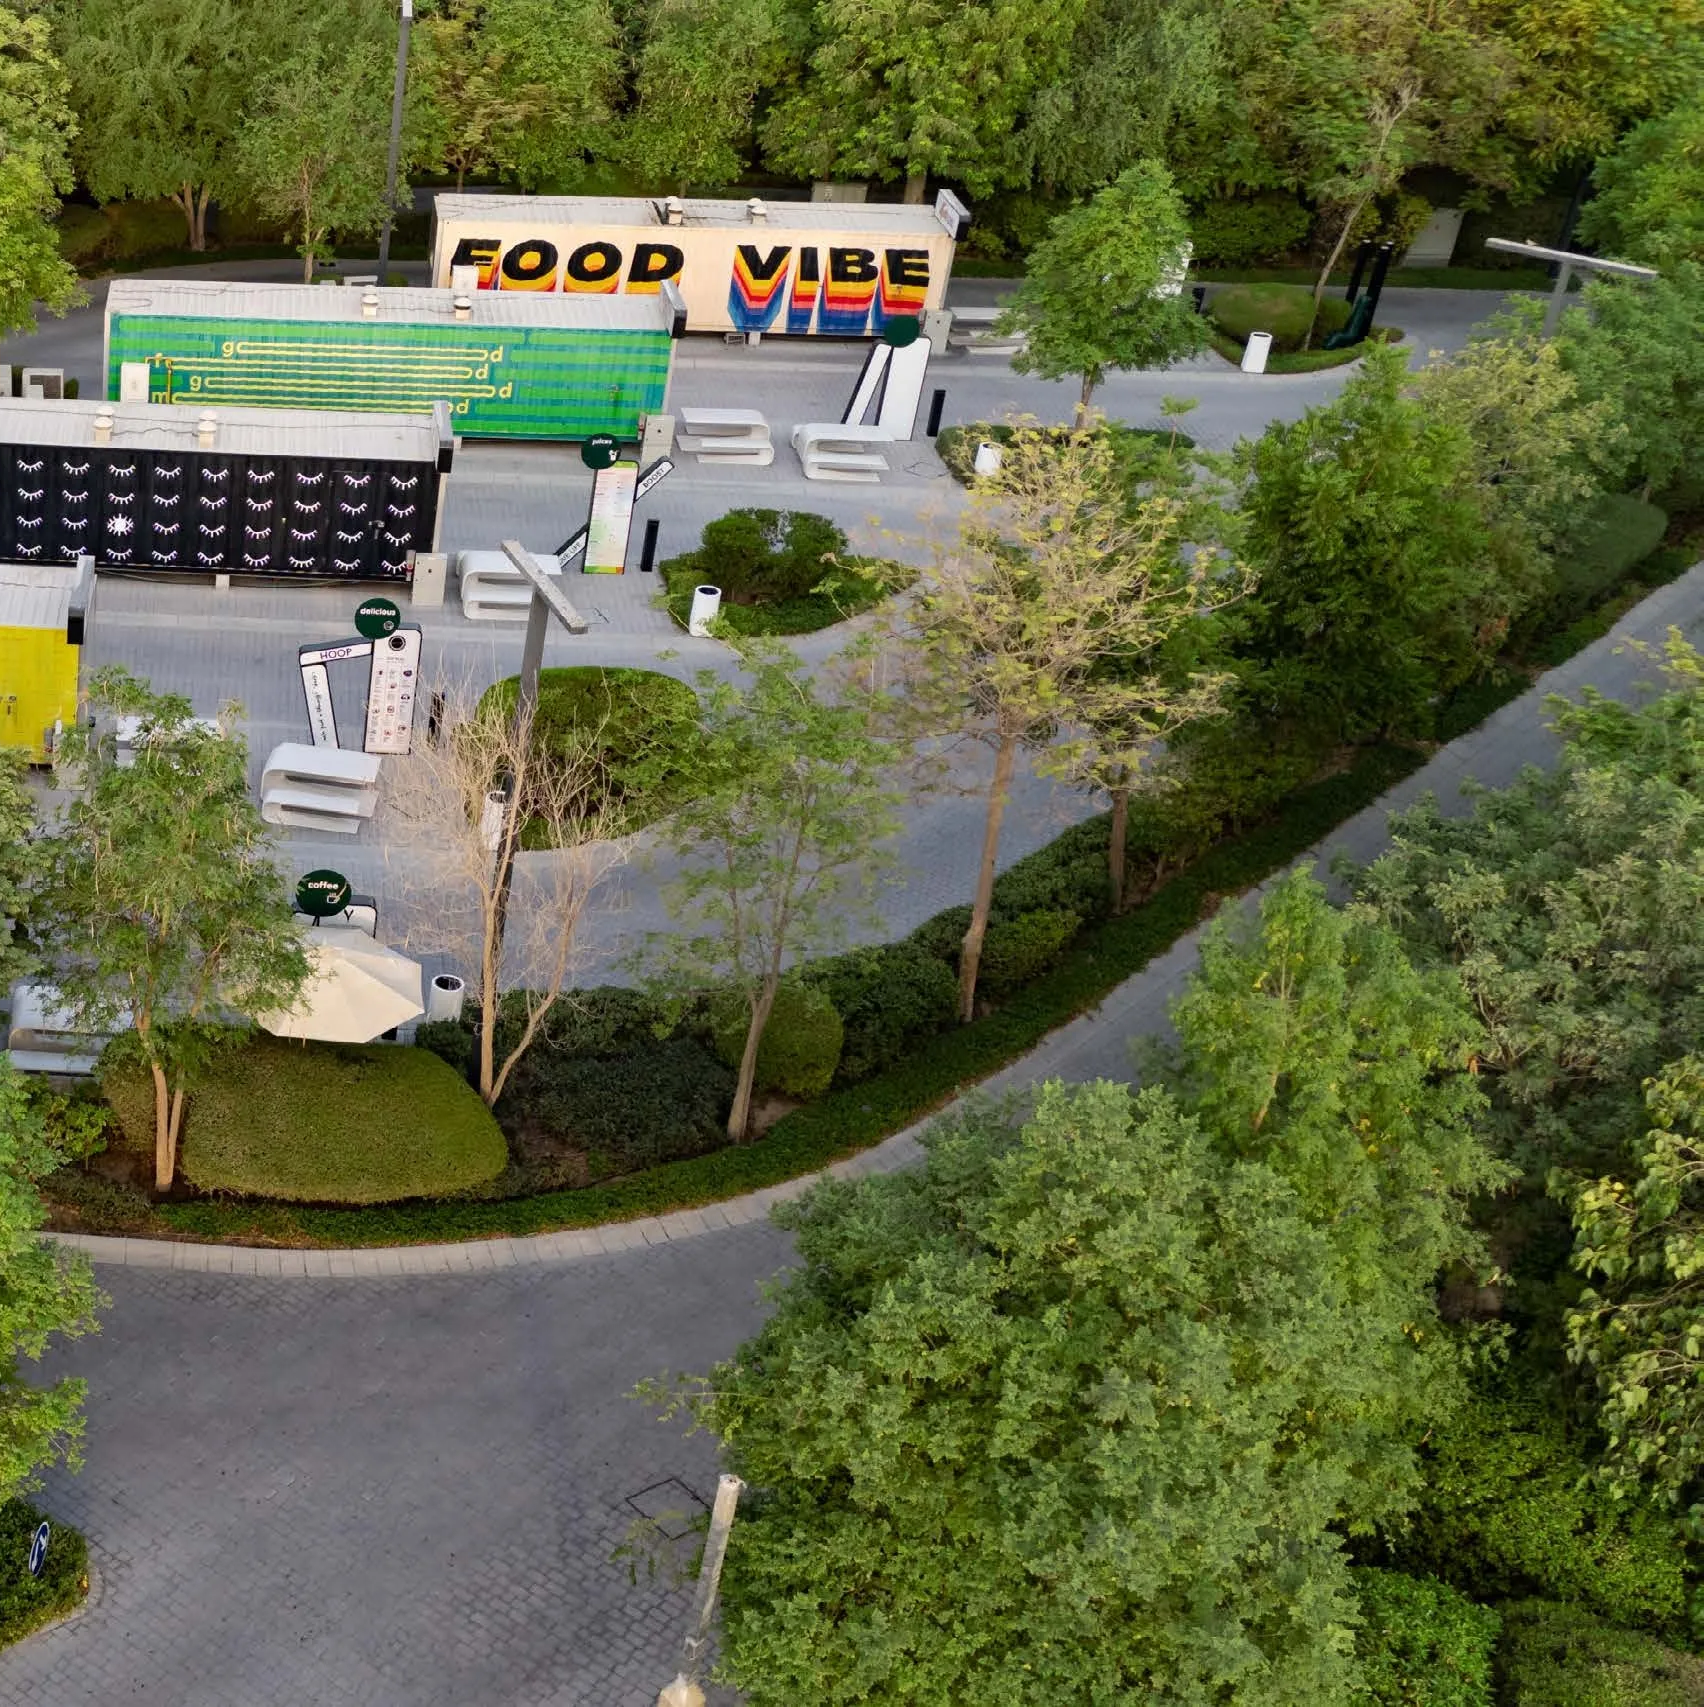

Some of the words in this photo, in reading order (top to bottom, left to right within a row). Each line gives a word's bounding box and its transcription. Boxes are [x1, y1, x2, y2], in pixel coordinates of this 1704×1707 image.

[451, 238, 684, 284] FOOD
[643, 469, 664, 488] BOOST
[360, 607, 396, 616] delicious
[319, 647, 353, 660] HOOP
[308, 880, 339, 889] coffee
